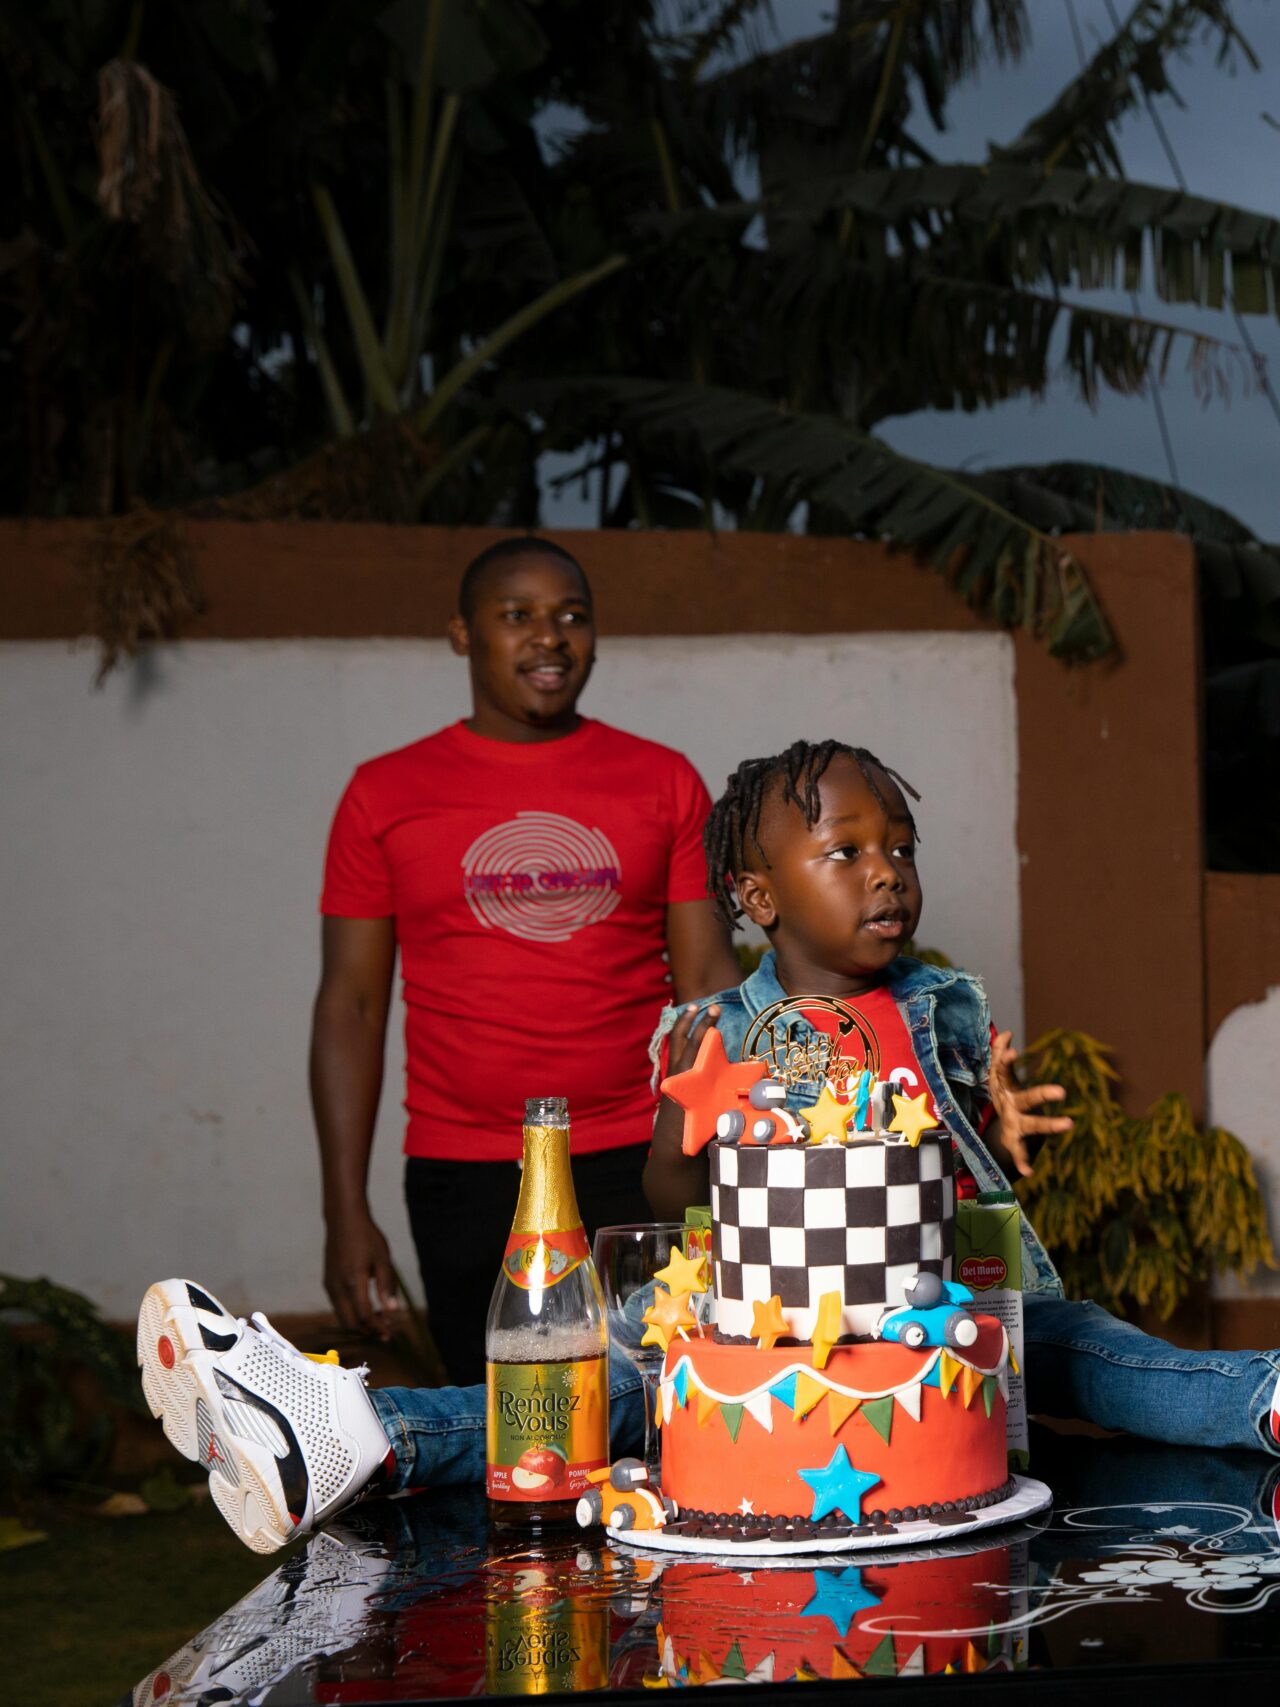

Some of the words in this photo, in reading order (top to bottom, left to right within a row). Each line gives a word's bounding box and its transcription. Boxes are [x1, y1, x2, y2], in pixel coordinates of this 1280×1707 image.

[757, 1023, 842, 1068] Happy
[962, 1267, 976, 1276] Del
[977, 1266, 1004, 1275] Monte
[497, 1390, 581, 1417] Rendez
[504, 1409, 570, 1434] Vous
[527, 1433, 567, 1441] ALCOHOLIC
[493, 1471, 508, 1479] APPLE
